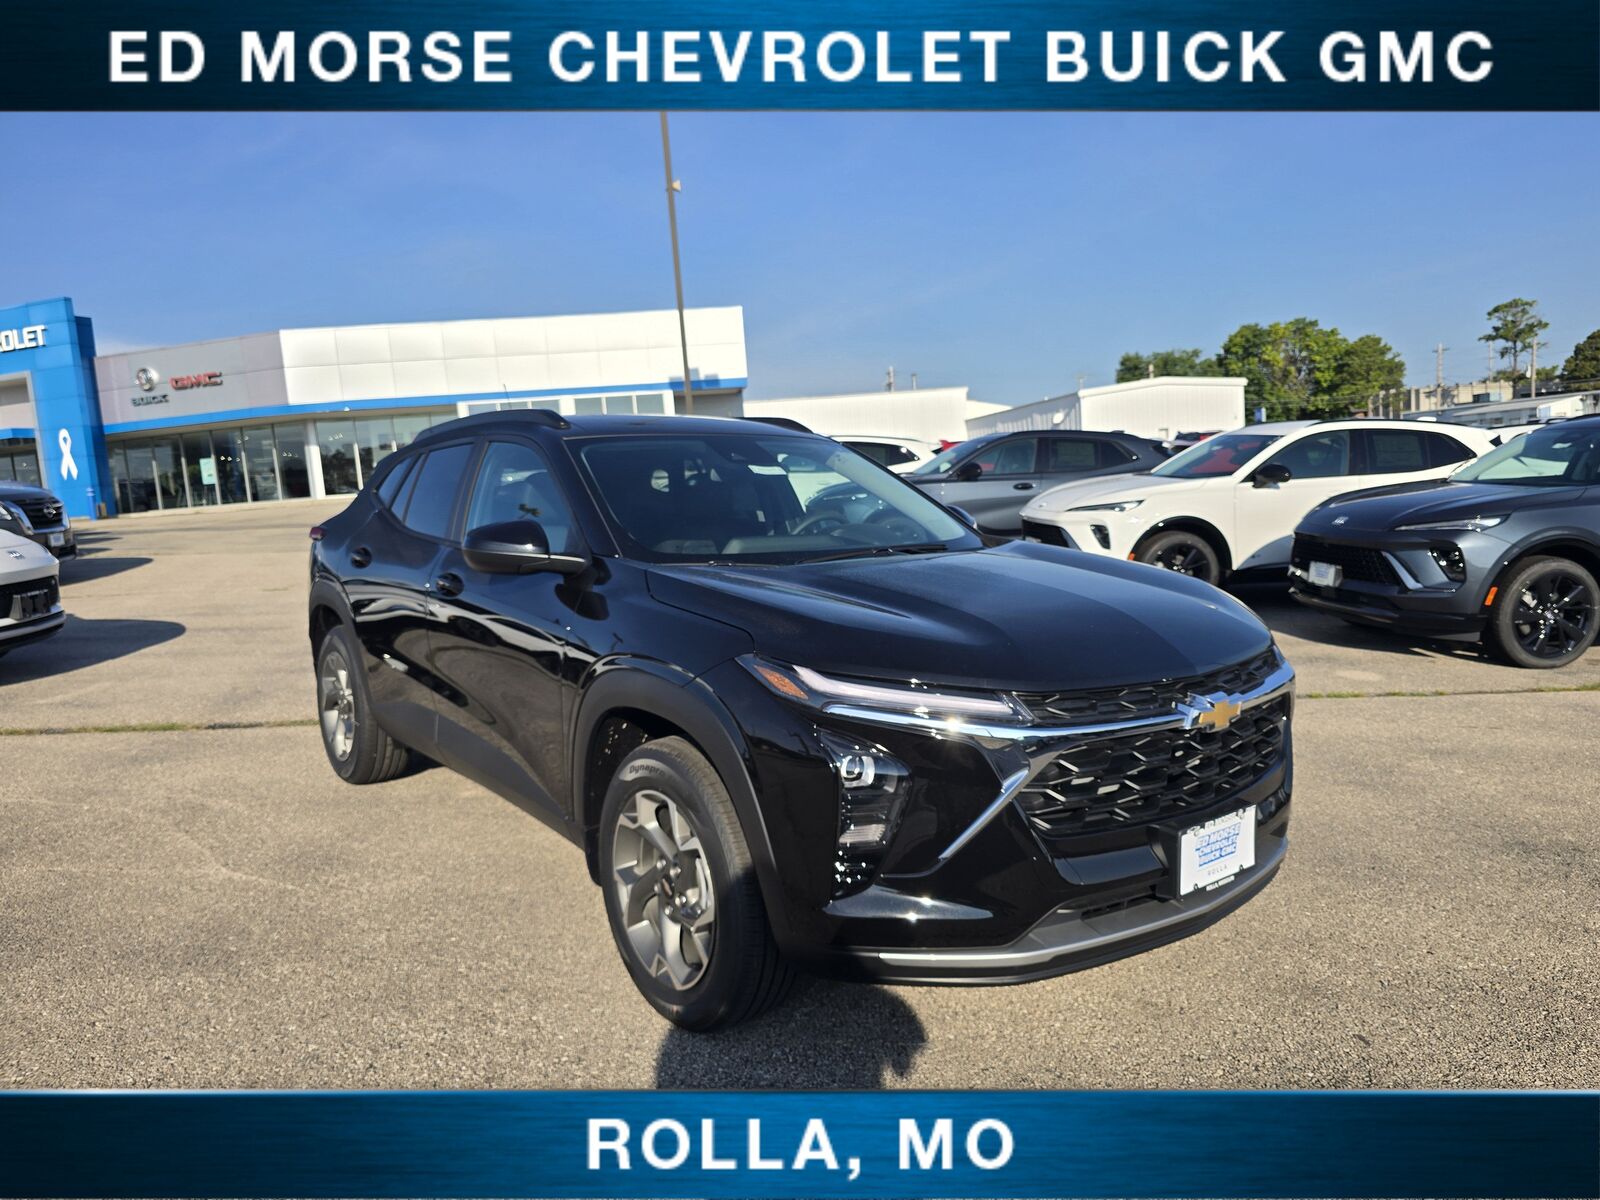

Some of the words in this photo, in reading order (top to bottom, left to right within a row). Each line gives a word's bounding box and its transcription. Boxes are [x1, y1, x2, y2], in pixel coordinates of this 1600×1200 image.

[0, 325, 46, 352] OLET
[170, 372, 223, 390] GMC
[131, 394, 169, 407] BUICK
[629, 764, 665, 777] Dynapro
